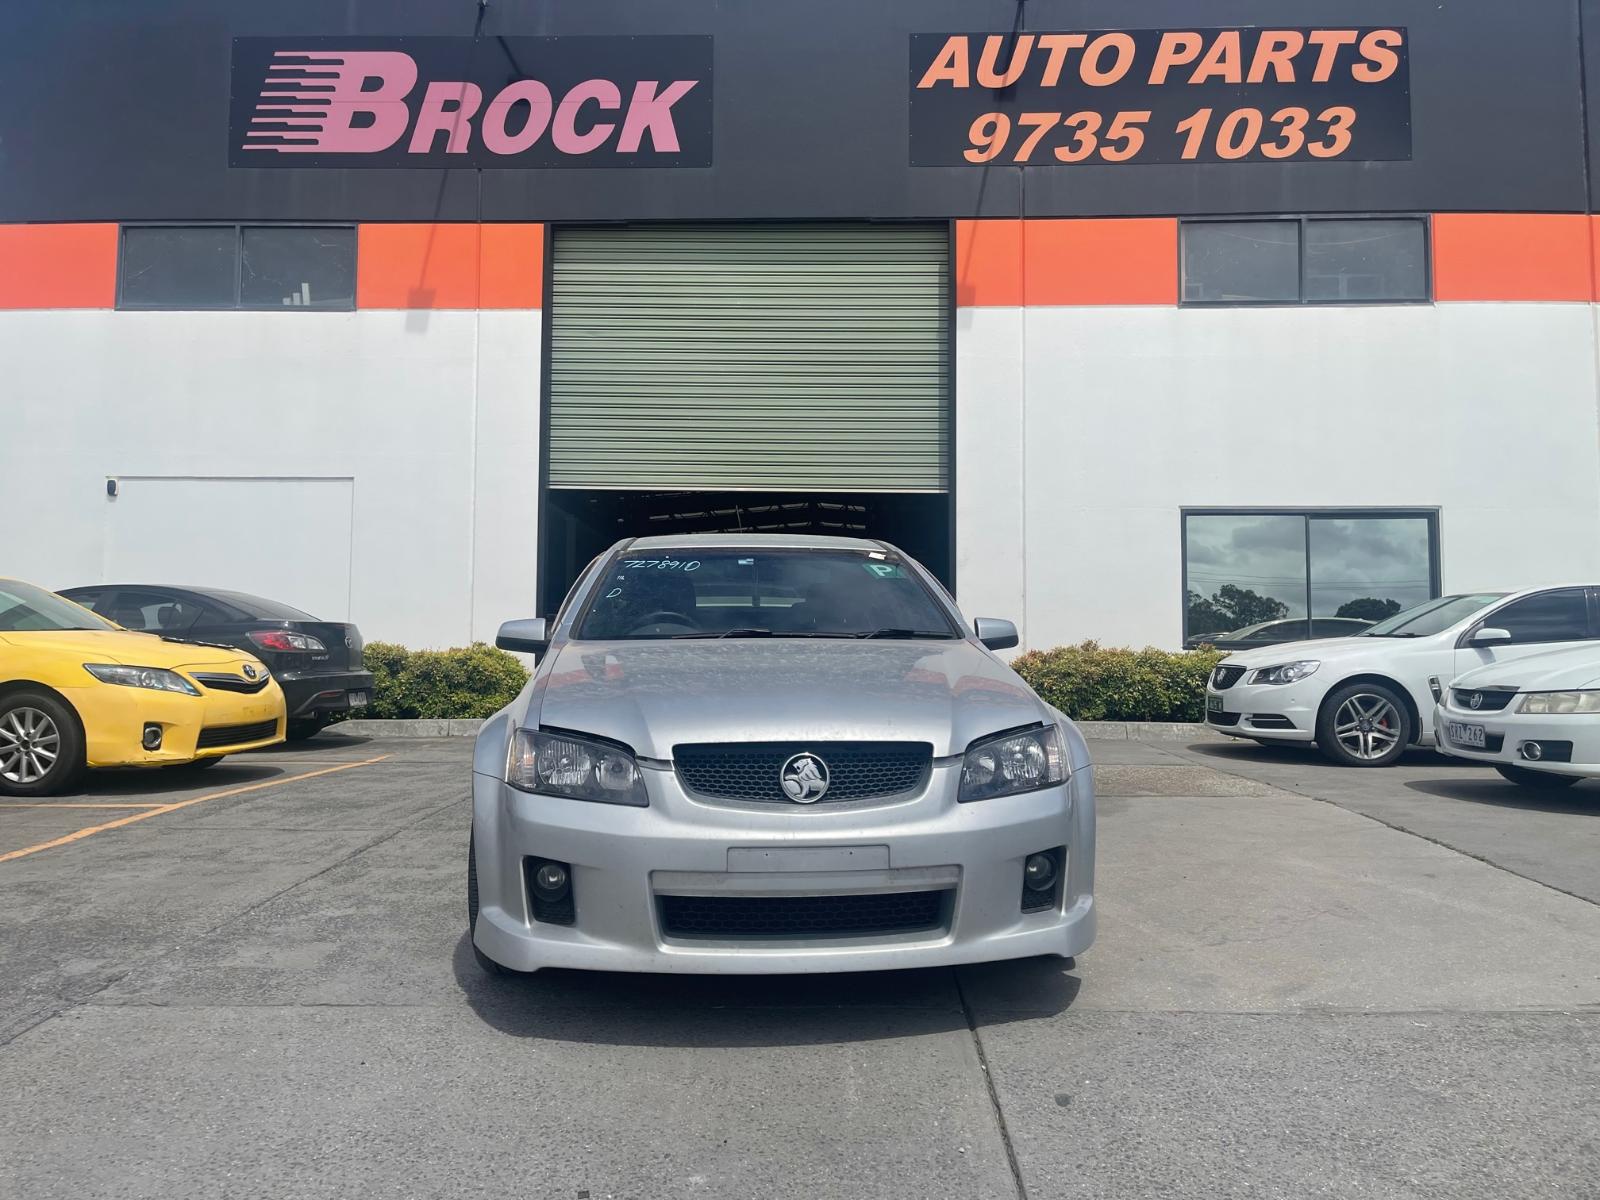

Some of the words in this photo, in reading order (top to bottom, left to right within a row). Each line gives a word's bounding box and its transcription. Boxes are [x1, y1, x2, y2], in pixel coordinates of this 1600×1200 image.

[917, 32, 1136, 89] AUTO
[1147, 29, 1404, 85] PARTS
[963, 110, 1152, 163] 9735
[1175, 106, 1357, 160] 1033
